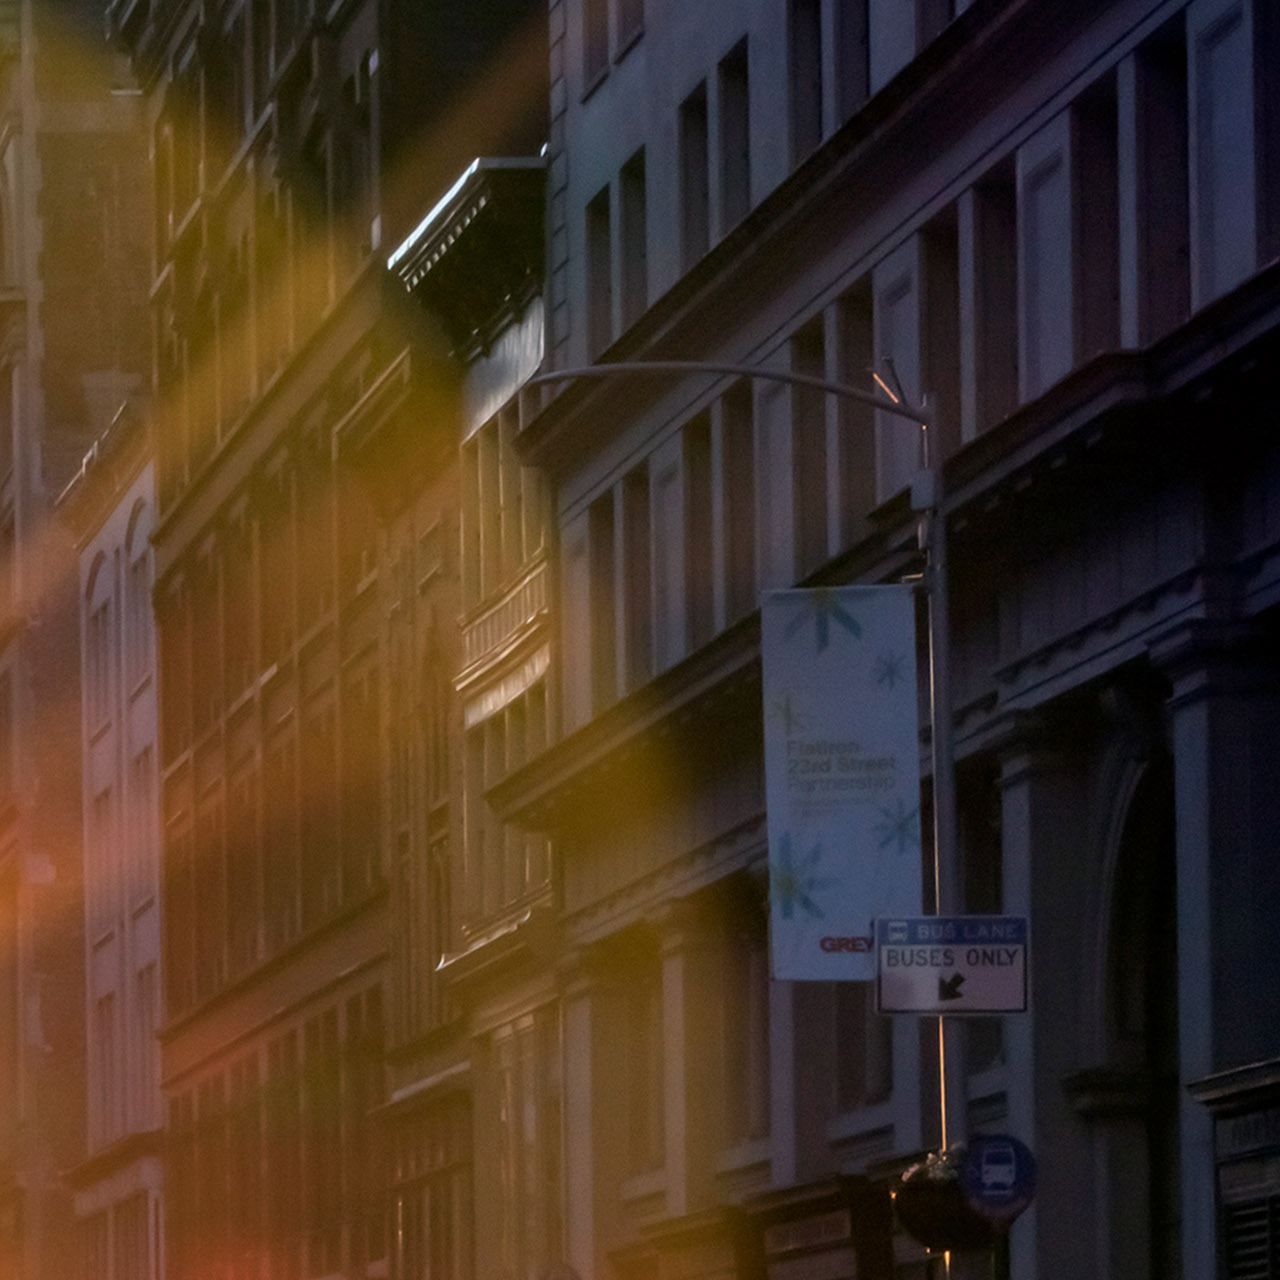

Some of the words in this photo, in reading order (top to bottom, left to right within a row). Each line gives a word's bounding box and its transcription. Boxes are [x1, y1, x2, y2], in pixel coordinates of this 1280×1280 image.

[787, 740, 860, 756] Flatiron
[788, 758, 831, 775] 23rd
[837, 755, 897, 773] Street
[787, 772, 896, 794] Partnership
[918, 923, 955, 940] BUS
[964, 922, 1017, 940] LANE
[886, 948, 955, 967] BUSES
[966, 948, 1019, 967] ONLY
